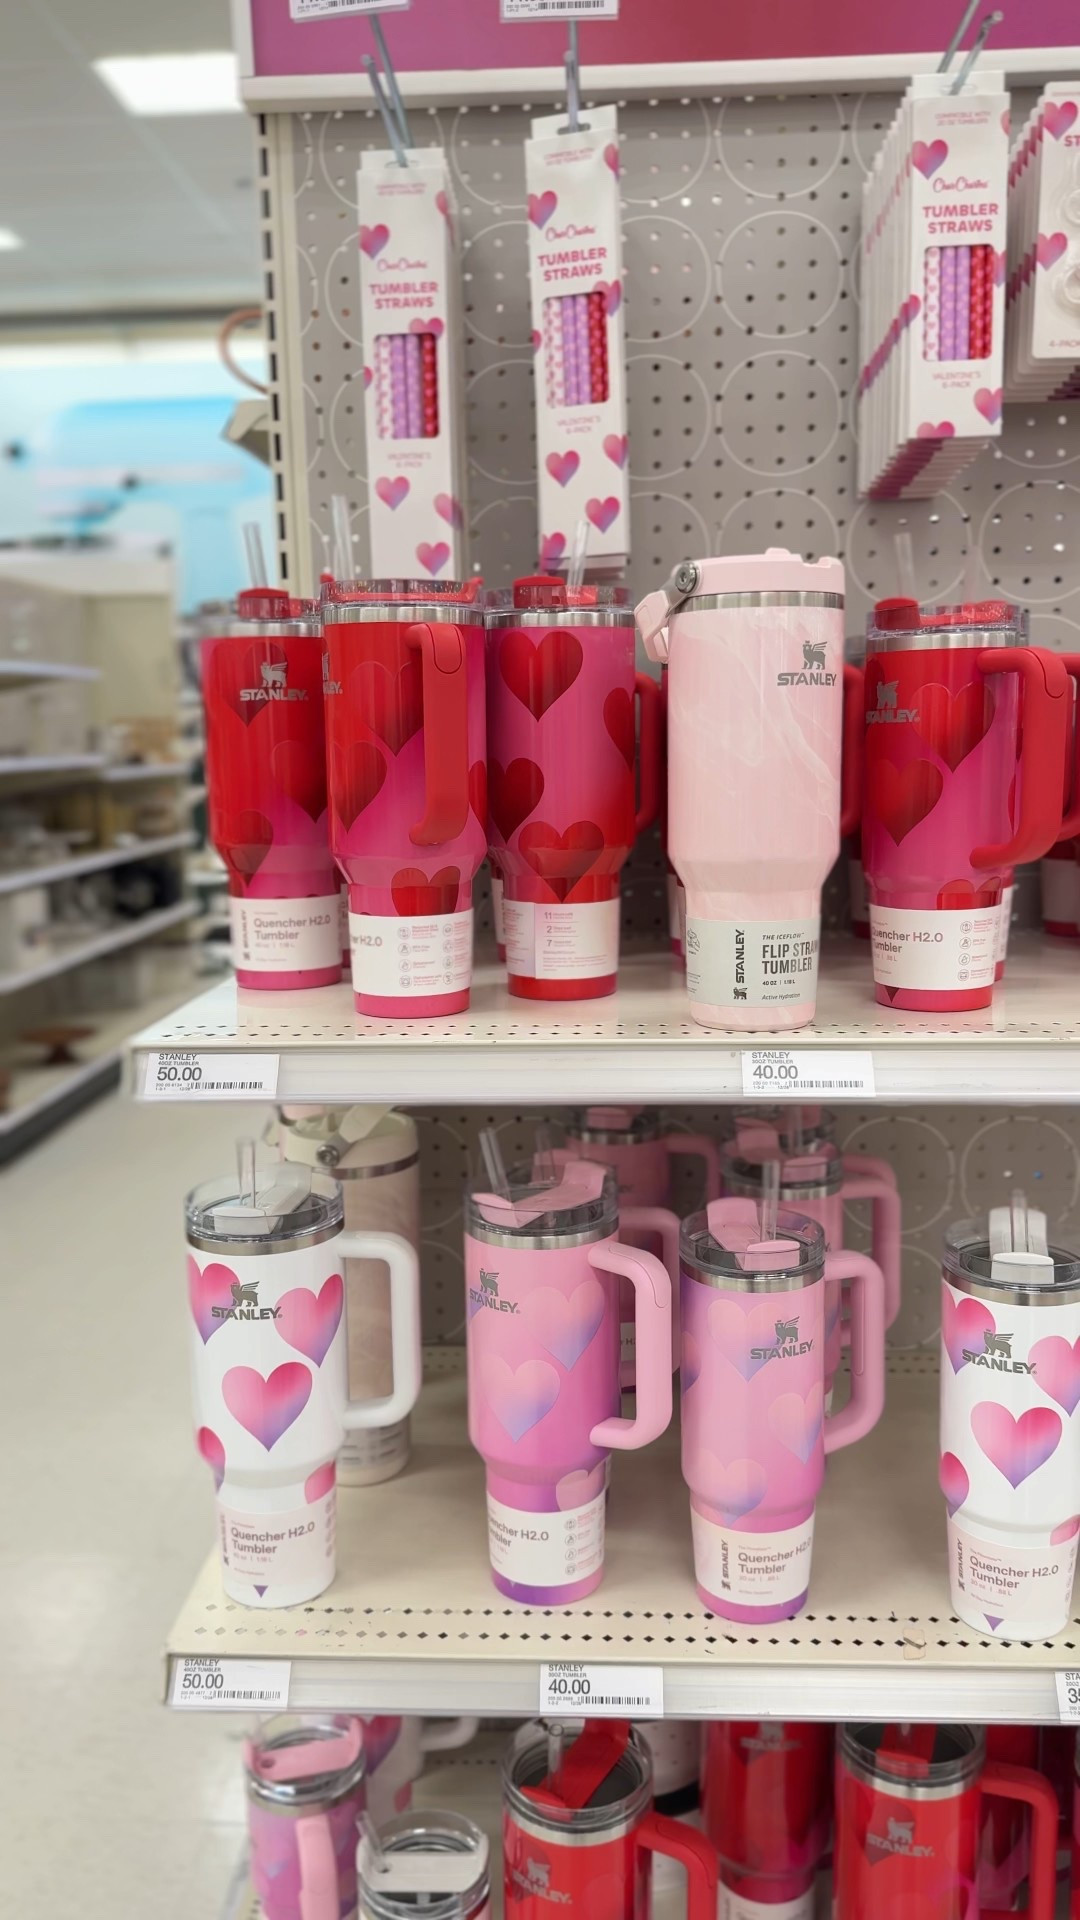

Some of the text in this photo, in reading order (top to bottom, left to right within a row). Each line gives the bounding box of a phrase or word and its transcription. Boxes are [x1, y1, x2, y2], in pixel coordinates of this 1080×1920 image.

[922, 203, 998, 219] TUMBLER
[928, 219, 993, 234] STRAWS
[537, 247, 607, 267] TUMBLER
[543, 263, 602, 281] STRAWS
[369, 281, 438, 295] TUMBLER
[375, 296, 434, 310] STRAWS
[777, 672, 837, 687] STANLEY
[239, 688, 307, 702] STANLEY
[253, 917, 306, 928] Quencher
[547, 925, 552, 934] 2
[254, 930, 300, 940] Tumbler
[912, 931, 944, 943] H2.0
[547, 939, 552, 947] 7
[735, 929, 745, 984] STANLEY
[762, 943, 790, 959] FLIP
[762, 957, 812, 974] TUMBLER
[158, 1053, 197, 1061] STANLEY
[752, 1051, 790, 1059] STANLEY
[156, 1066, 202, 1081] 50.00
[752, 1064, 798, 1079] 40.00
[470, 1288, 519, 1314] STANLEY
[211, 1306, 282, 1321] STANLEY
[750, 1339, 814, 1360] STANLEY
[962, 1348, 1037, 1374] STANLEY
[231, 1526, 287, 1542] Quencher
[288, 1521, 316, 1539] H2.0
[520, 1529, 549, 1541] H2.0
[231, 1538, 278, 1554] Tumbler
[737, 1550, 794, 1563] Quencher
[738, 1563, 786, 1575] Tumbler
[969, 1555, 1059, 1578] Quencher H2.0
[969, 1566, 1020, 1589] Tumbler
[184, 1659, 220, 1667] STANLEY
[548, 1664, 585, 1672] STANLEY
[182, 1673, 224, 1689] 50.00
[548, 1679, 591, 1695] 40.00
[1068, 1687, 1080, 1704] 3
